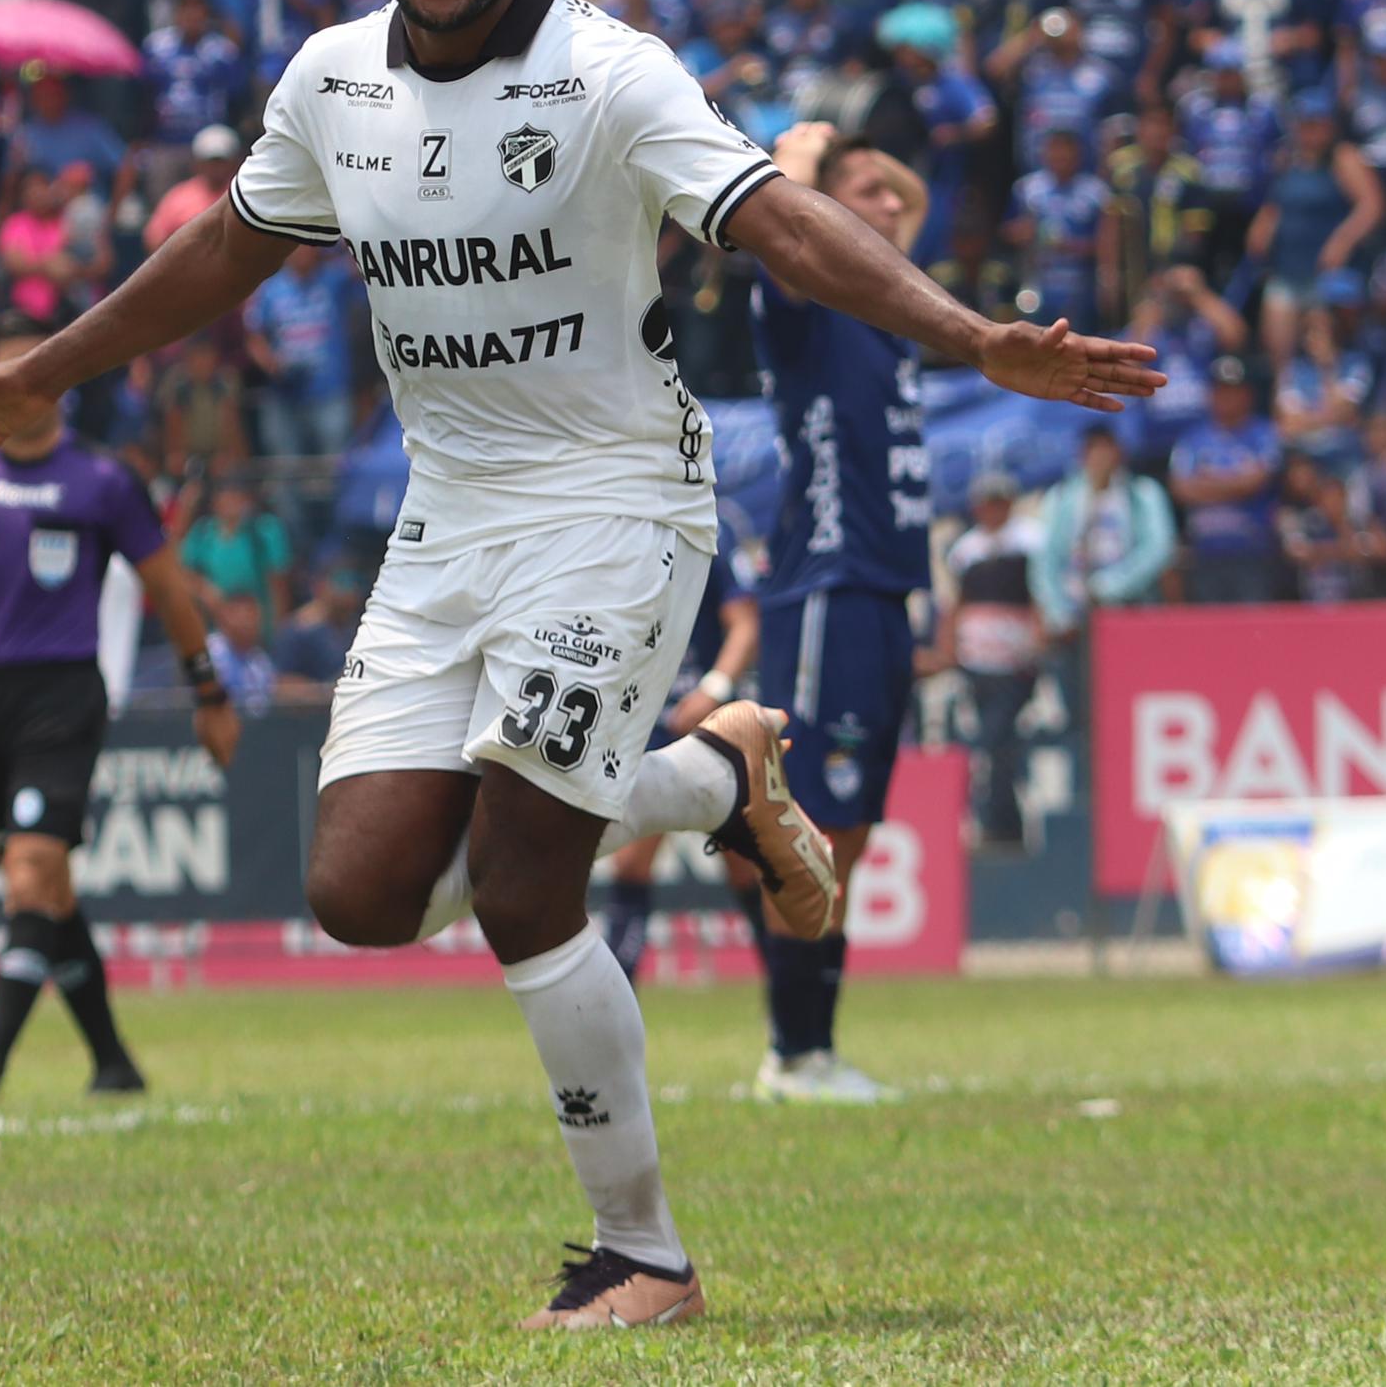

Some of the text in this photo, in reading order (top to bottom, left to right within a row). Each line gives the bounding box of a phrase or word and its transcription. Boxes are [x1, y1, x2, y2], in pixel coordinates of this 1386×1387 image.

[532, 93, 587, 108] DELIVERY EXPRESS
[335, 151, 392, 171] KELME
[422, 135, 447, 178] Z
[422, 188, 446, 197] GAS
[346, 227, 572, 287] ANRURAL
[395, 312, 584, 369] GANA777
[534, 629, 623, 662] LIGA GUATE
[553, 644, 595, 665] BANRURAL
[499, 669, 602, 773] 33
